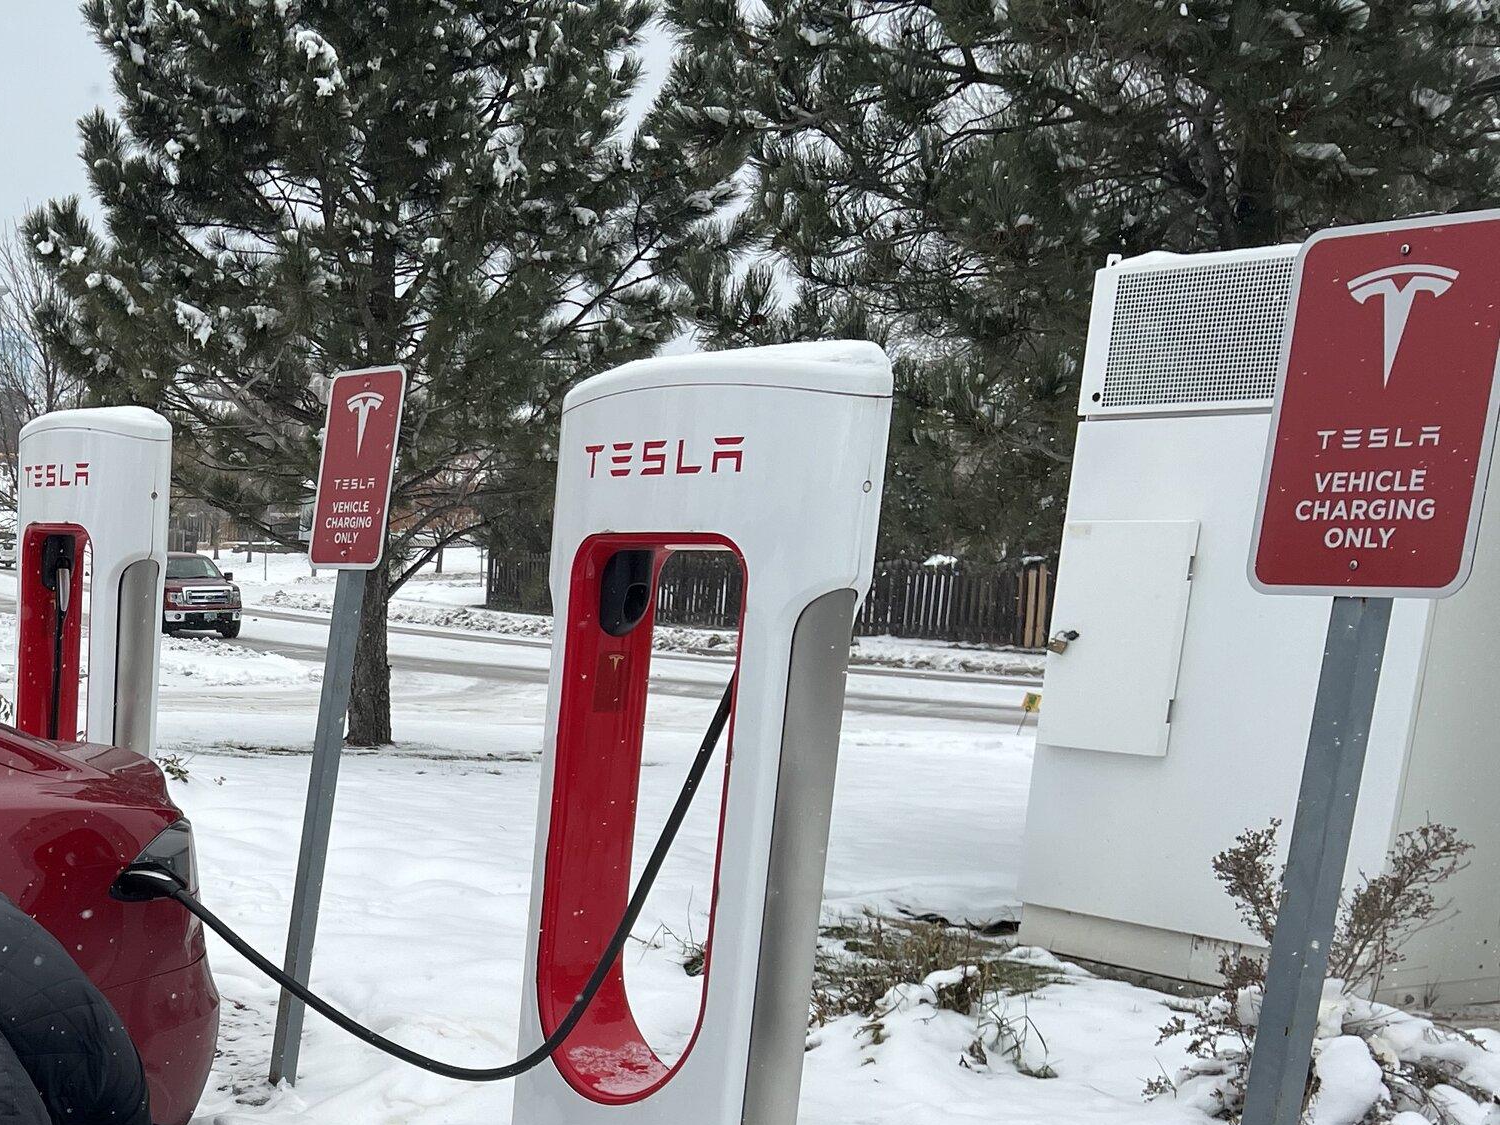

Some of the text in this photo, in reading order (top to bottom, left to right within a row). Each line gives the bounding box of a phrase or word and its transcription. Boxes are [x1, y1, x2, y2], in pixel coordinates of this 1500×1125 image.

[1316, 425, 1442, 450] TESLA
[585, 436, 745, 479] TESLA
[24, 462, 90, 488] TESLA
[333, 477, 376, 490] TESLA
[1314, 469, 1427, 493] VEHICLE
[332, 501, 371, 514] VEHICLE
[1295, 498, 1436, 521] CHARGING
[325, 516, 373, 529] CHARGING
[333, 532, 360, 544] ONLY
[1323, 527, 1397, 549] ONLY
